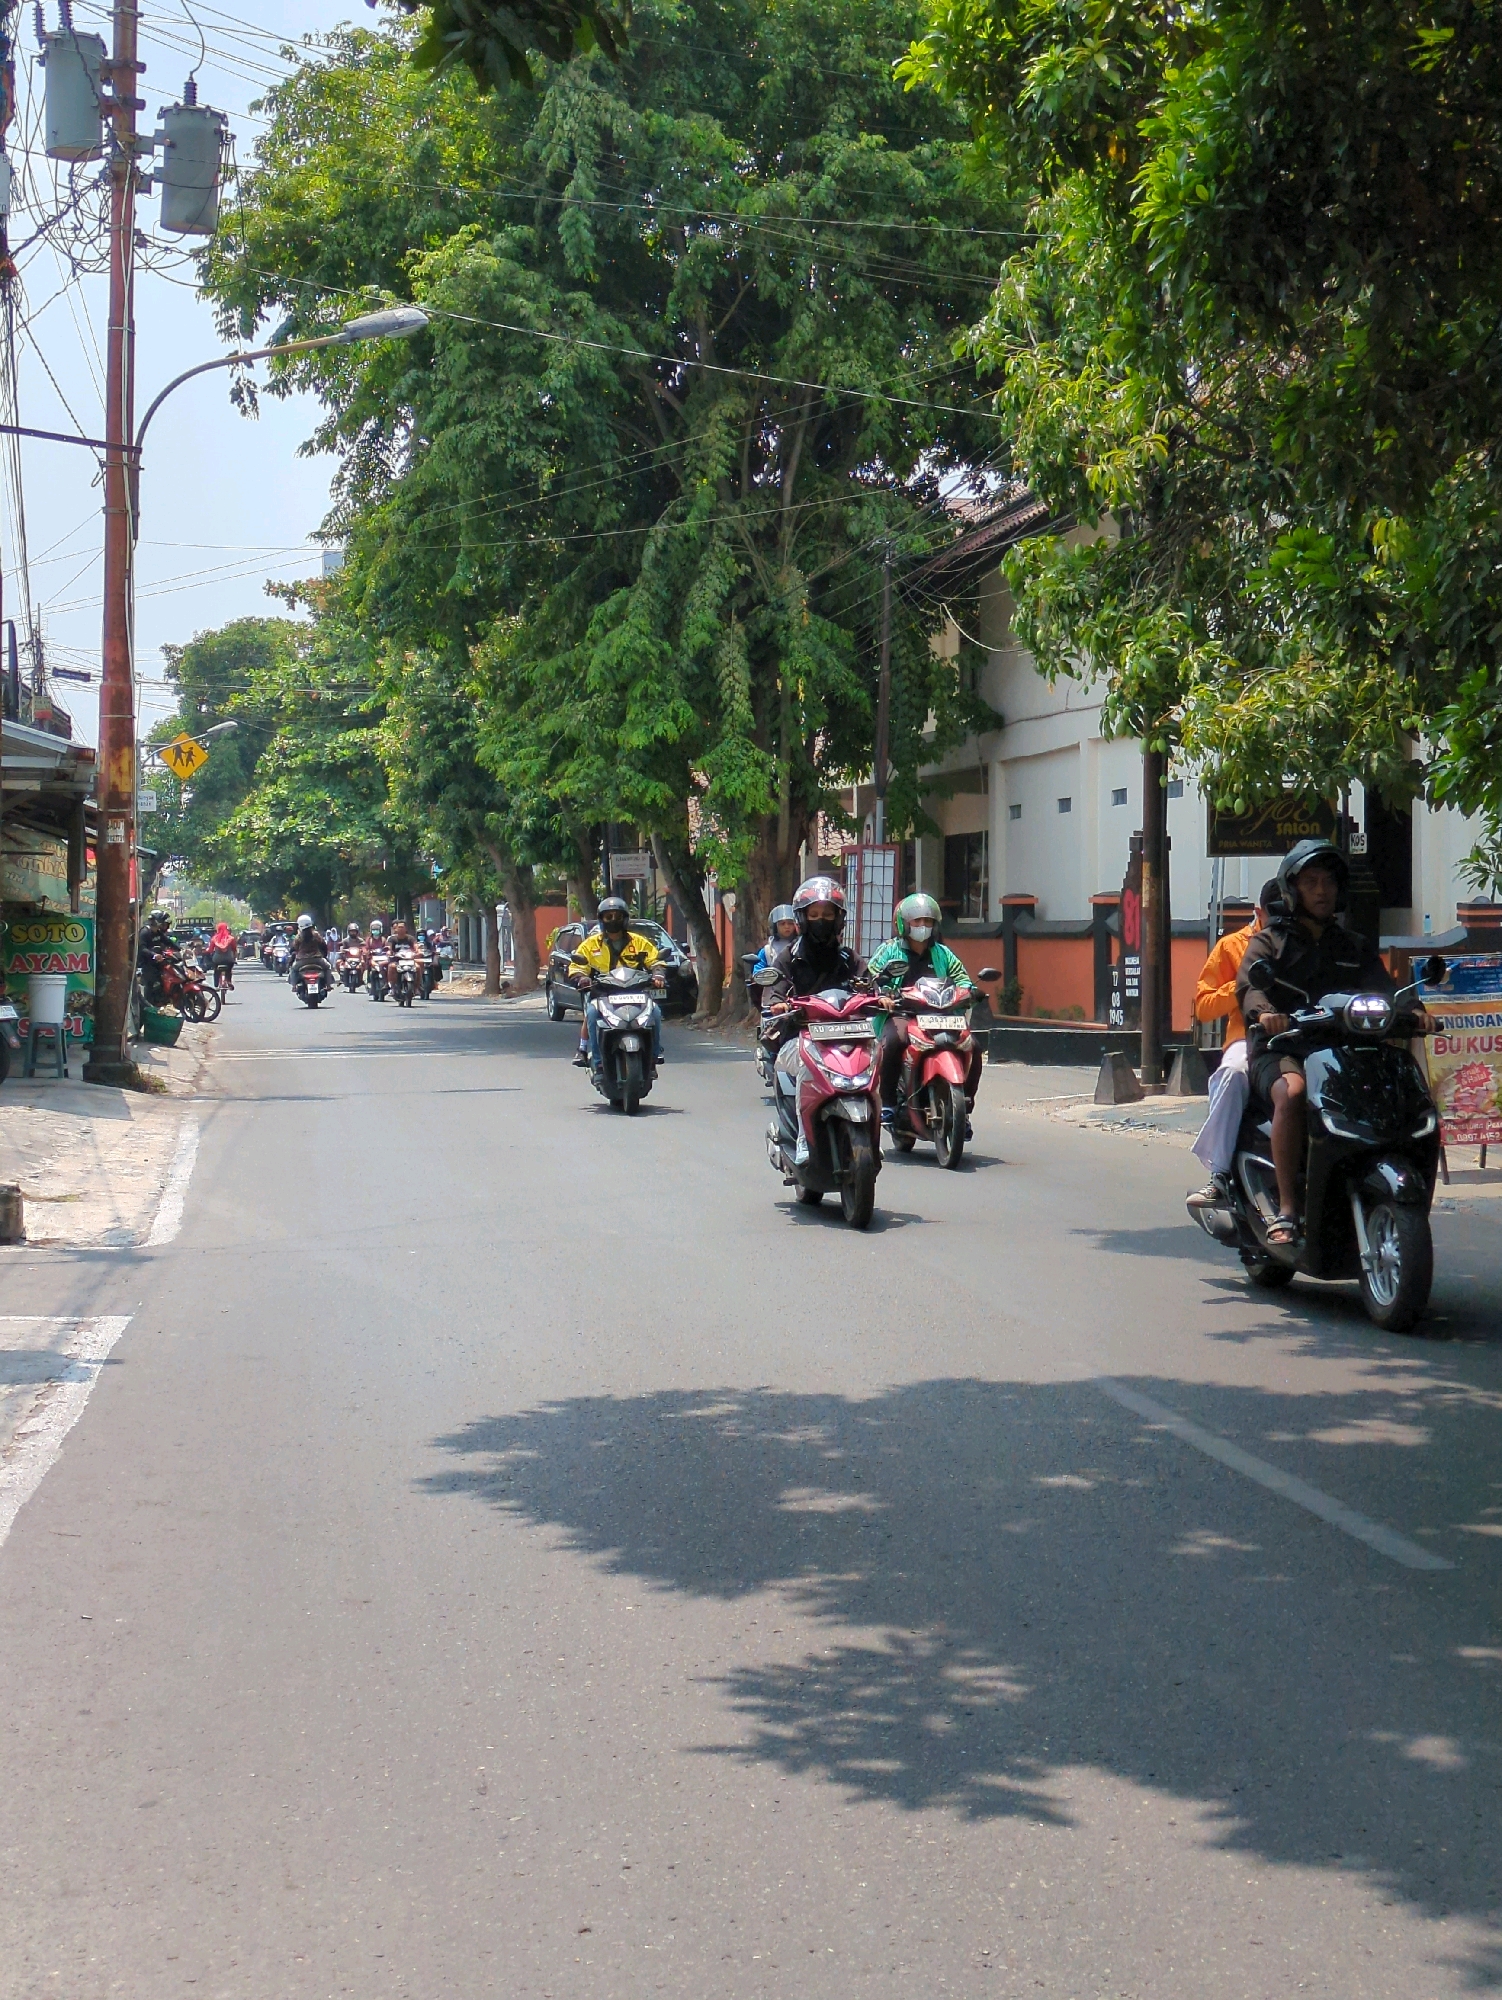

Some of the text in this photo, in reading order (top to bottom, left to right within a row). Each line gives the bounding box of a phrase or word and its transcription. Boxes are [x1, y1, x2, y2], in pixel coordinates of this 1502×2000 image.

[1218, 840, 1238, 849] PRIA
[1240, 839, 1273, 849] WANITA
[1350, 834, 1366, 847] KOS
[11, 922, 87, 944] SOTO
[8, 952, 92, 974] AYAM
[1109, 1009, 1124, 1026] 1945
[1433, 1036, 1462, 1056] BU
